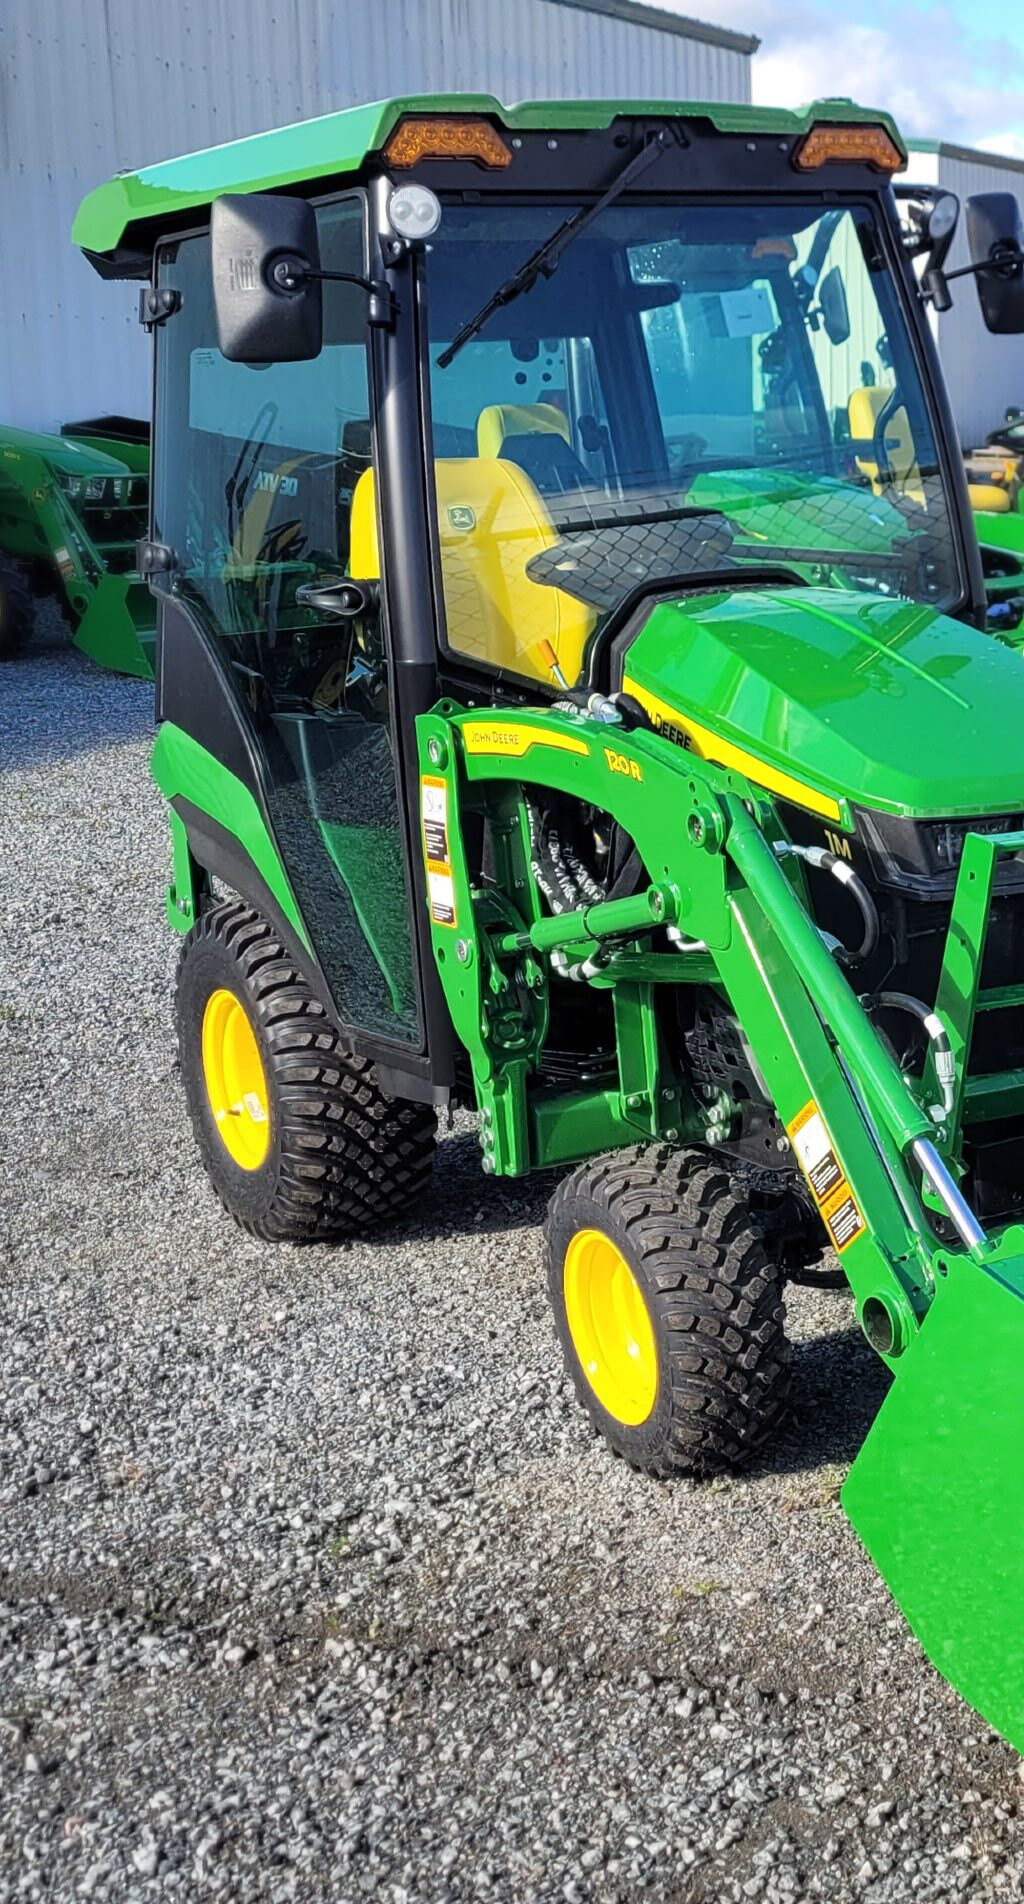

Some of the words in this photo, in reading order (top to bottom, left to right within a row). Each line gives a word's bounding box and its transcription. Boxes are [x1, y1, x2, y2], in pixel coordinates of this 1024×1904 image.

[471, 730, 491, 743] JOHN
[492, 731, 520, 745] DEERE
[655, 712, 692, 752] DEERE
[603, 746, 643, 784] 120R
[824, 829, 852, 861] 1M
